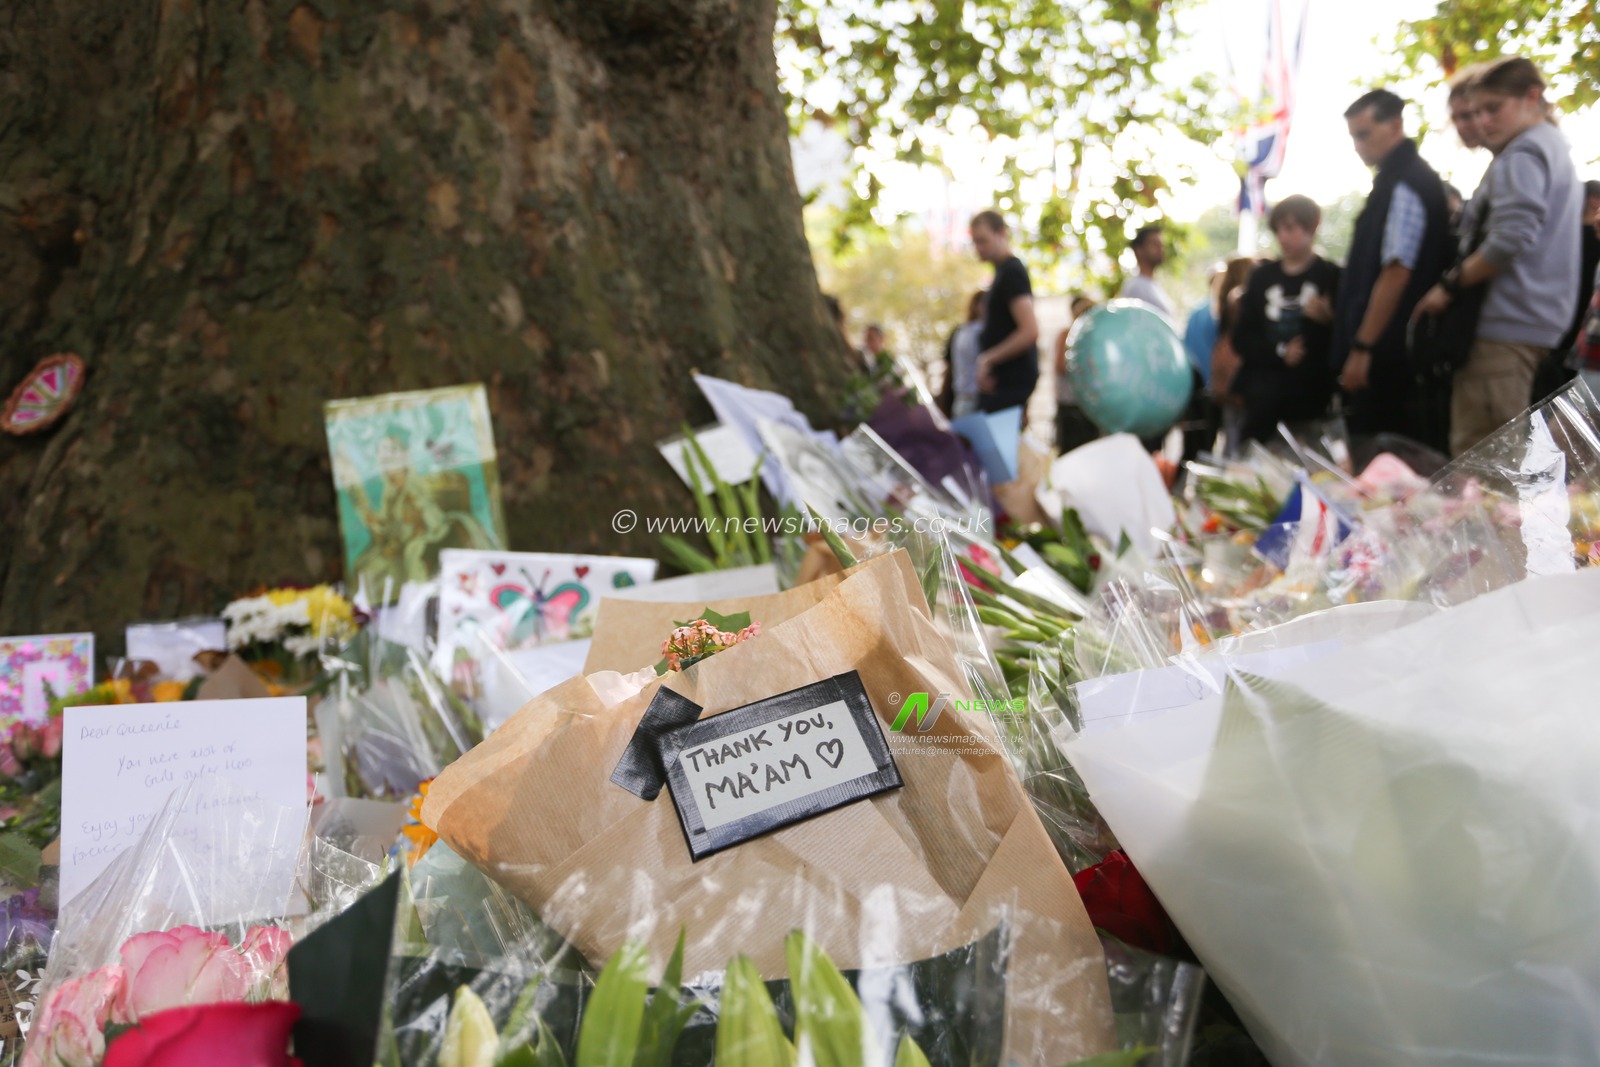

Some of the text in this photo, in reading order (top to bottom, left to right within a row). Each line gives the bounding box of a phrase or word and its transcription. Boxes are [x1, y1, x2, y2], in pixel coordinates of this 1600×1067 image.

[80, 713, 182, 740] Dear Queenie
[685, 712, 834, 773] THANK YOU,
[149, 752, 179, 767] were
[704, 753, 812, 810] MA'AM
[81, 820, 118, 842] Enjoy
[72, 842, 122, 866] forever
